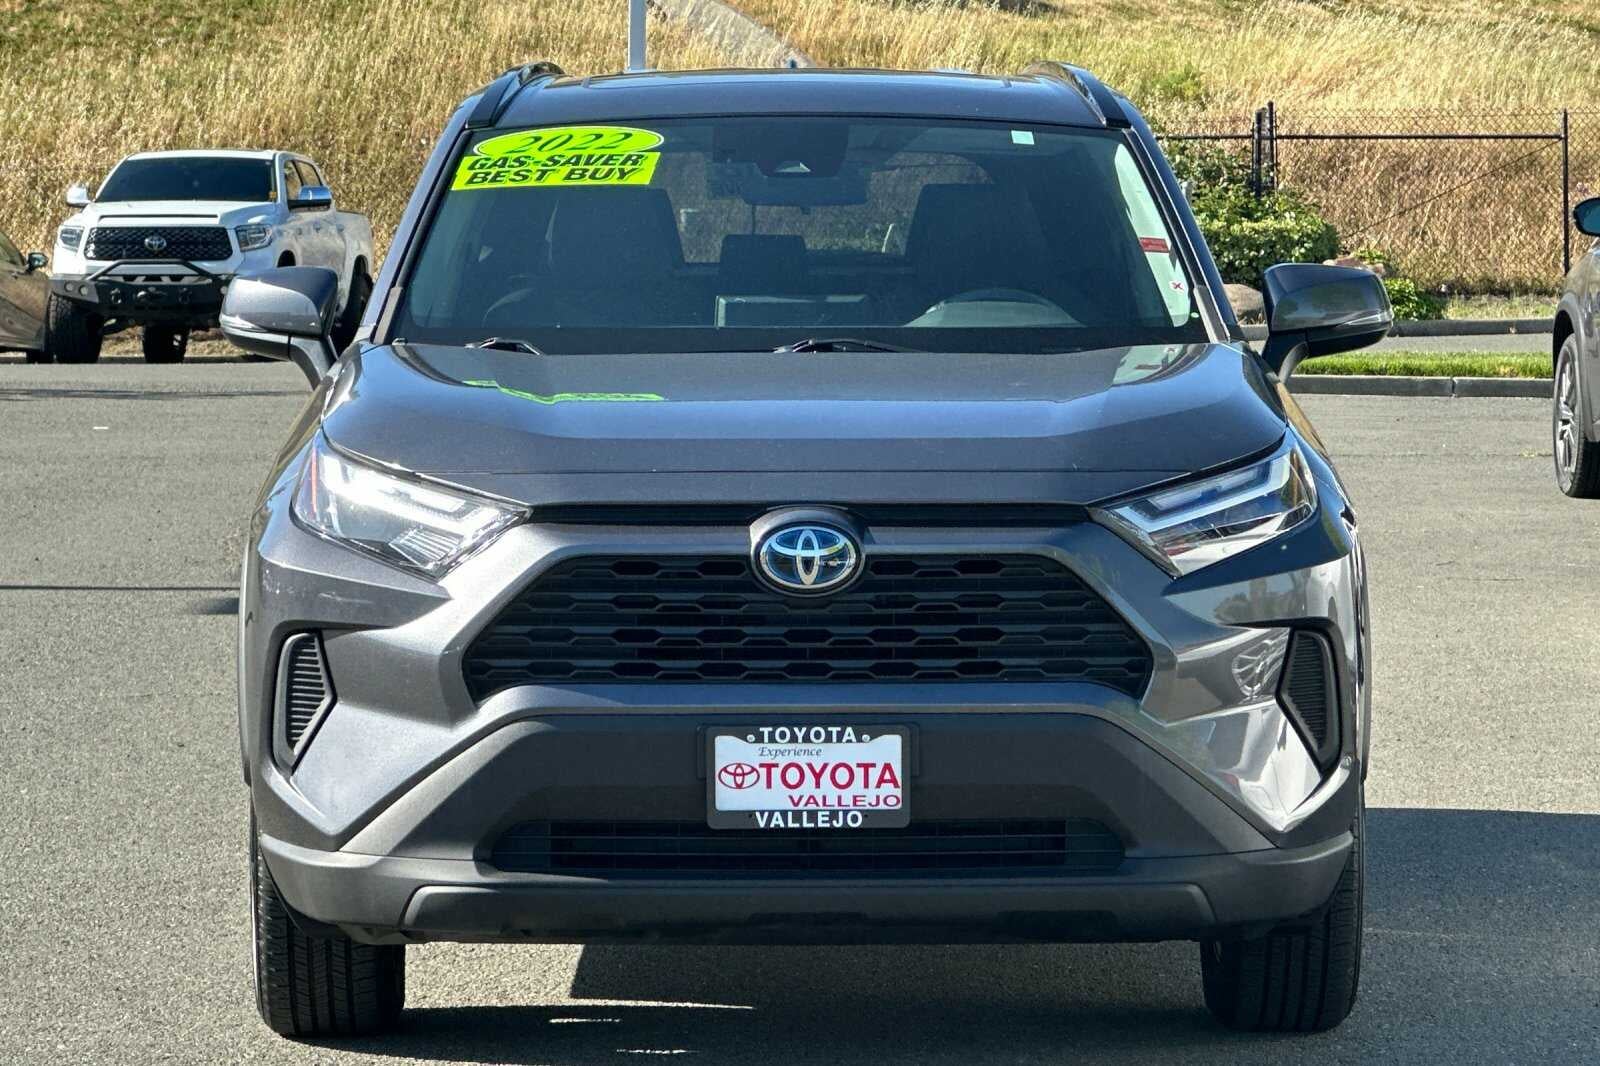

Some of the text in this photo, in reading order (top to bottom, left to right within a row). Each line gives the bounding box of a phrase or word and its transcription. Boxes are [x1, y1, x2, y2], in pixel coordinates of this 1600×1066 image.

[506, 132, 633, 153] 2022
[467, 153, 645, 171] GAS-SAVER
[465, 166, 640, 185] BEST BUY
[759, 727, 857, 743] TOYOTA
[758, 746, 822, 760] Experience
[759, 762, 900, 790] TOYOTA
[788, 794, 901, 808] VALLEJO
[756, 810, 863, 828] VALLEJO
